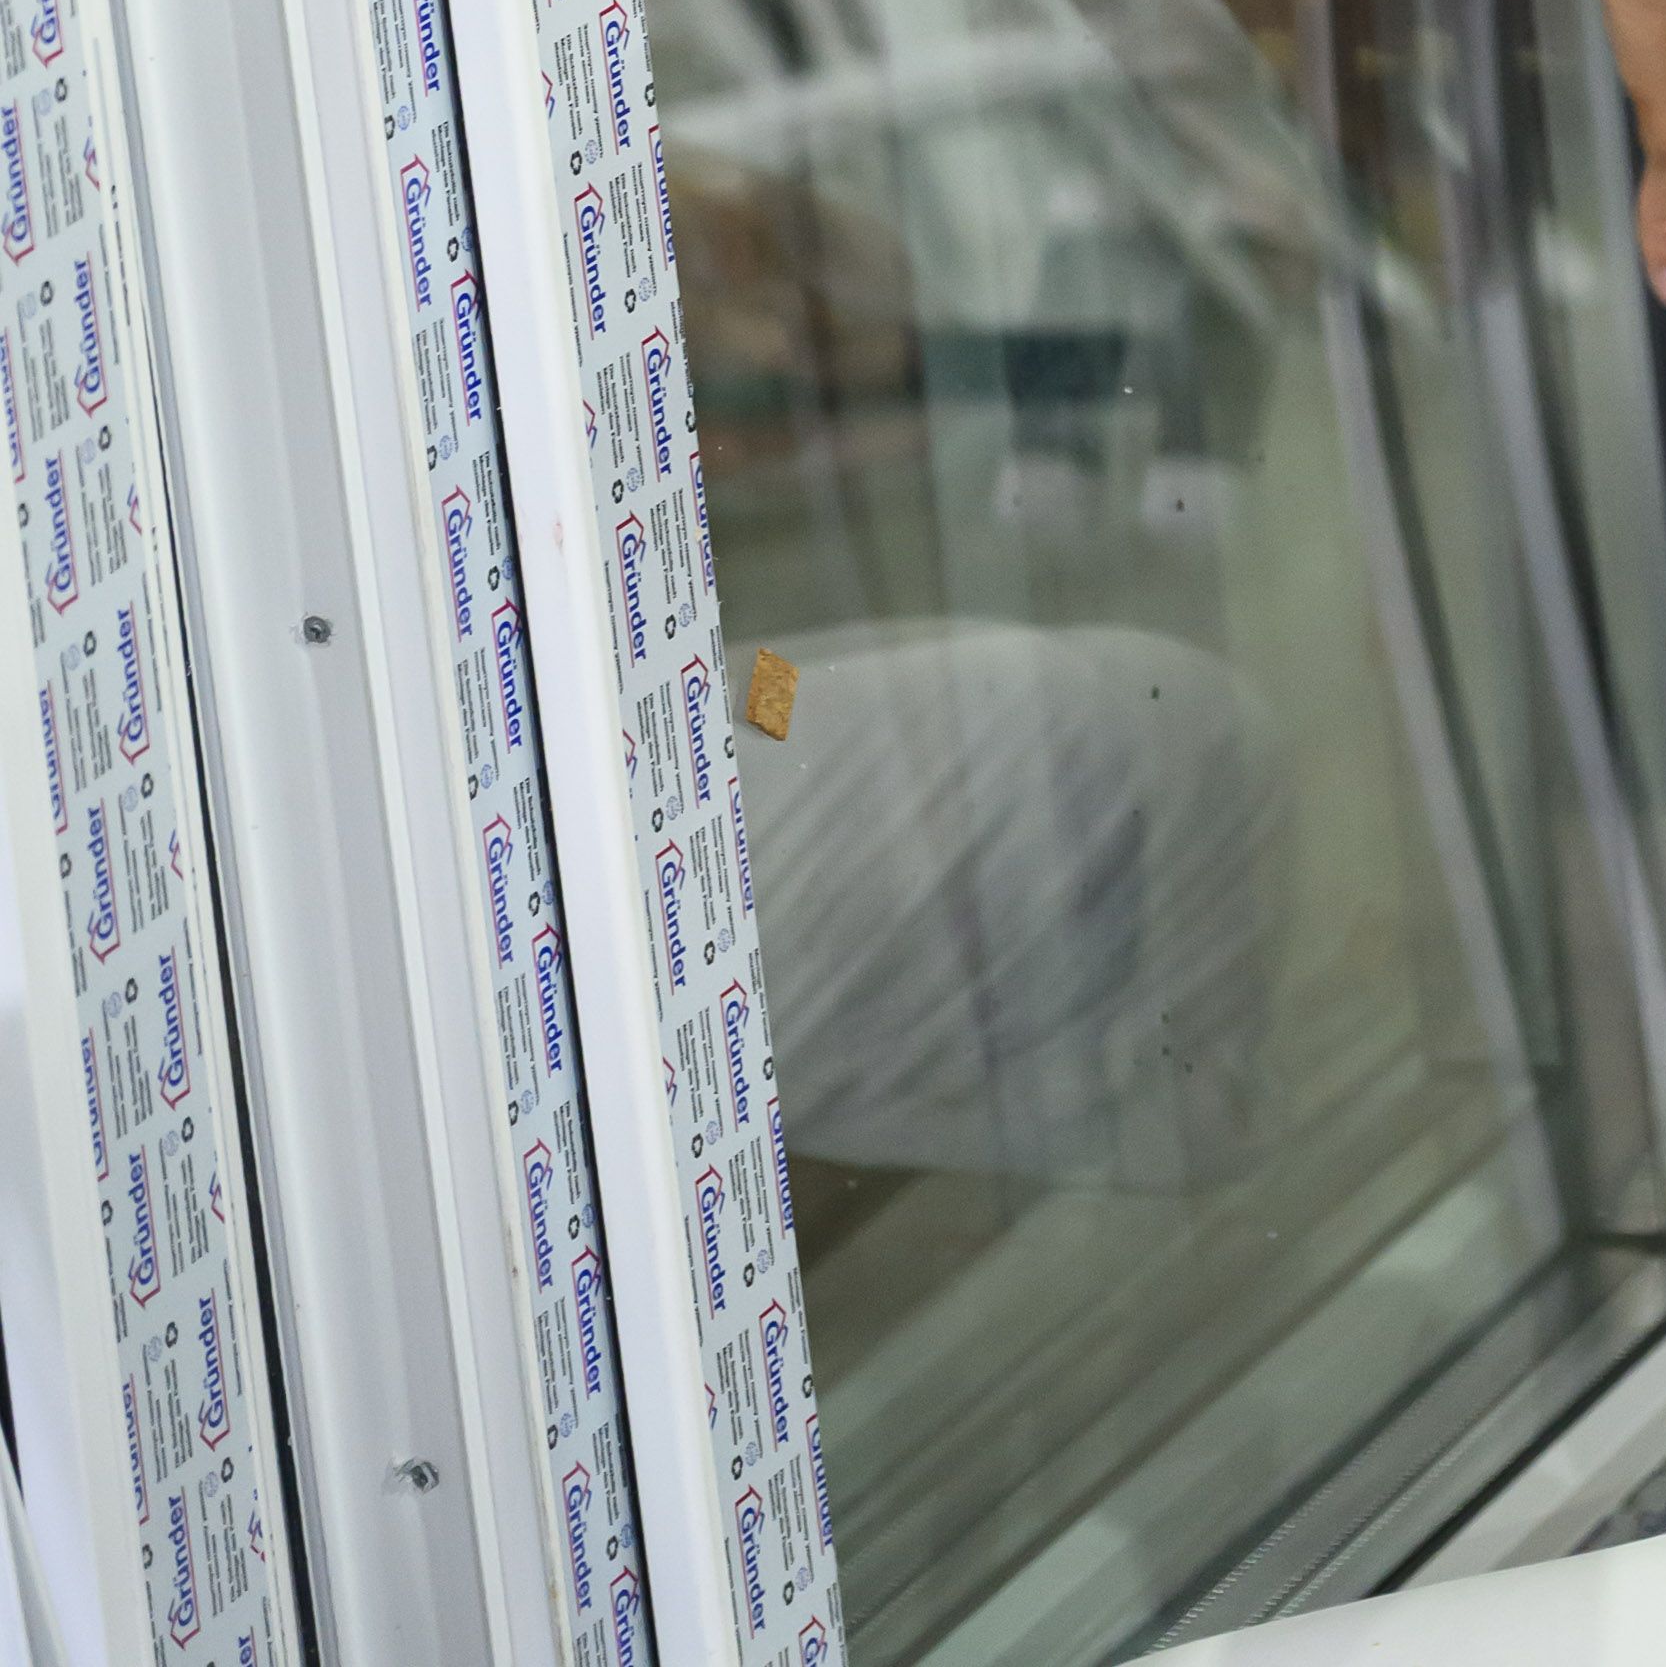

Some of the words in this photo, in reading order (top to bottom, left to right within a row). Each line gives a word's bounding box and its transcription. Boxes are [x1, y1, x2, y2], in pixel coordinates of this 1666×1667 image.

[605, 20, 631, 148] Gründer
[406, 176, 433, 307] Gründer
[580, 205, 607, 333] Gründer
[457, 291, 482, 422] Gründer
[648, 347, 673, 475] Gründer
[448, 508, 474, 637] Gründer
[624, 533, 647, 661] Gründer
[497, 621, 522, 749] Gründer
[687, 677, 711, 802] Gründer
[489, 835, 514, 964] Gründer
[662, 861, 688, 987] Gründer
[538, 945, 564, 1073] Gründer
[726, 1000, 750, 1125] Gründer
[529, 1162, 555, 1287] Gründer
[702, 1186, 727, 1310] Gründer
[577, 1268, 602, 1396] Gründer
[765, 1322, 790, 1445] Gründer
[568, 1483, 593, 1610] Gründer
[742, 1507, 765, 1631] Gründer
